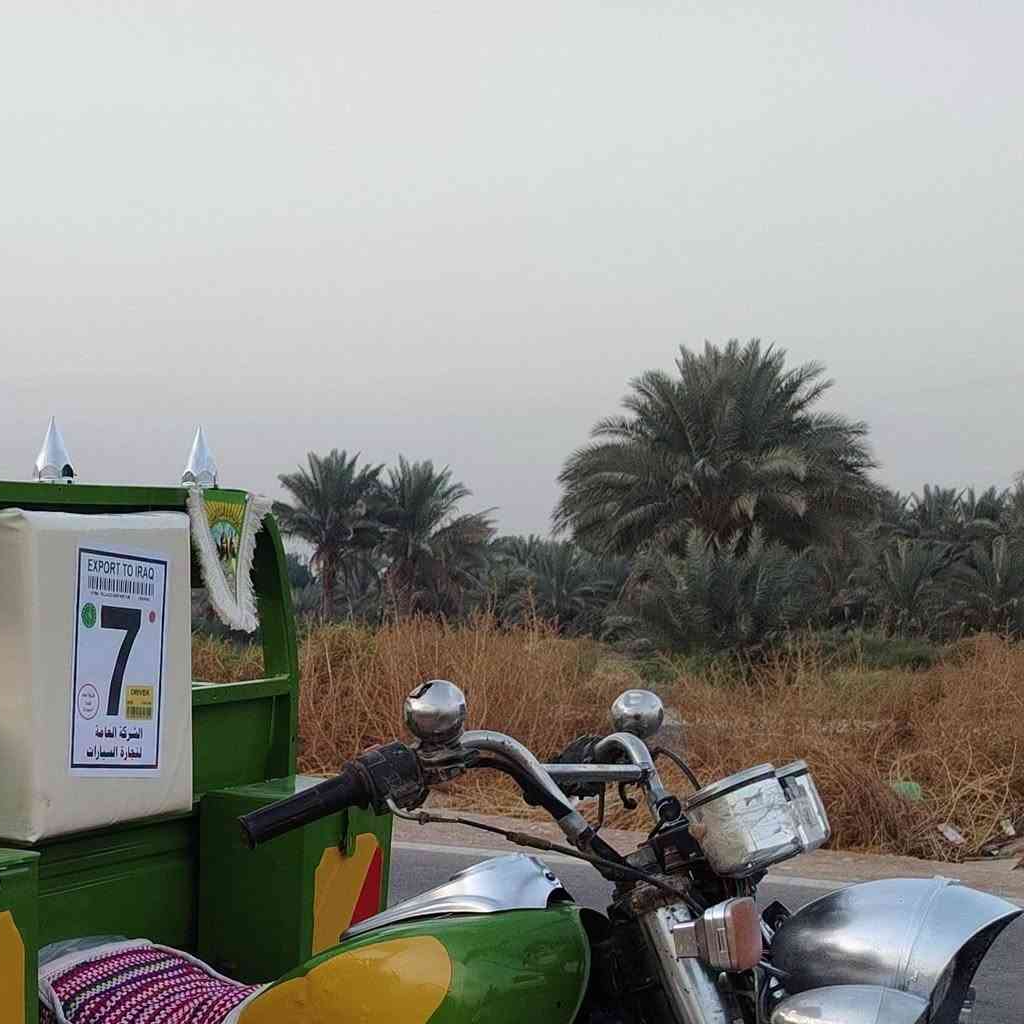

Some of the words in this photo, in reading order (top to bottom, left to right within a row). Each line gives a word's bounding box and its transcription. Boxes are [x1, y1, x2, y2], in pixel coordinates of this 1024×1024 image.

[87, 559, 121, 576] EXPORT
[122, 563, 134, 577] TO
[135, 565, 155, 580] IRAQ
[101, 605, 142, 716] 7
[119, 726, 143, 741] الشركة
